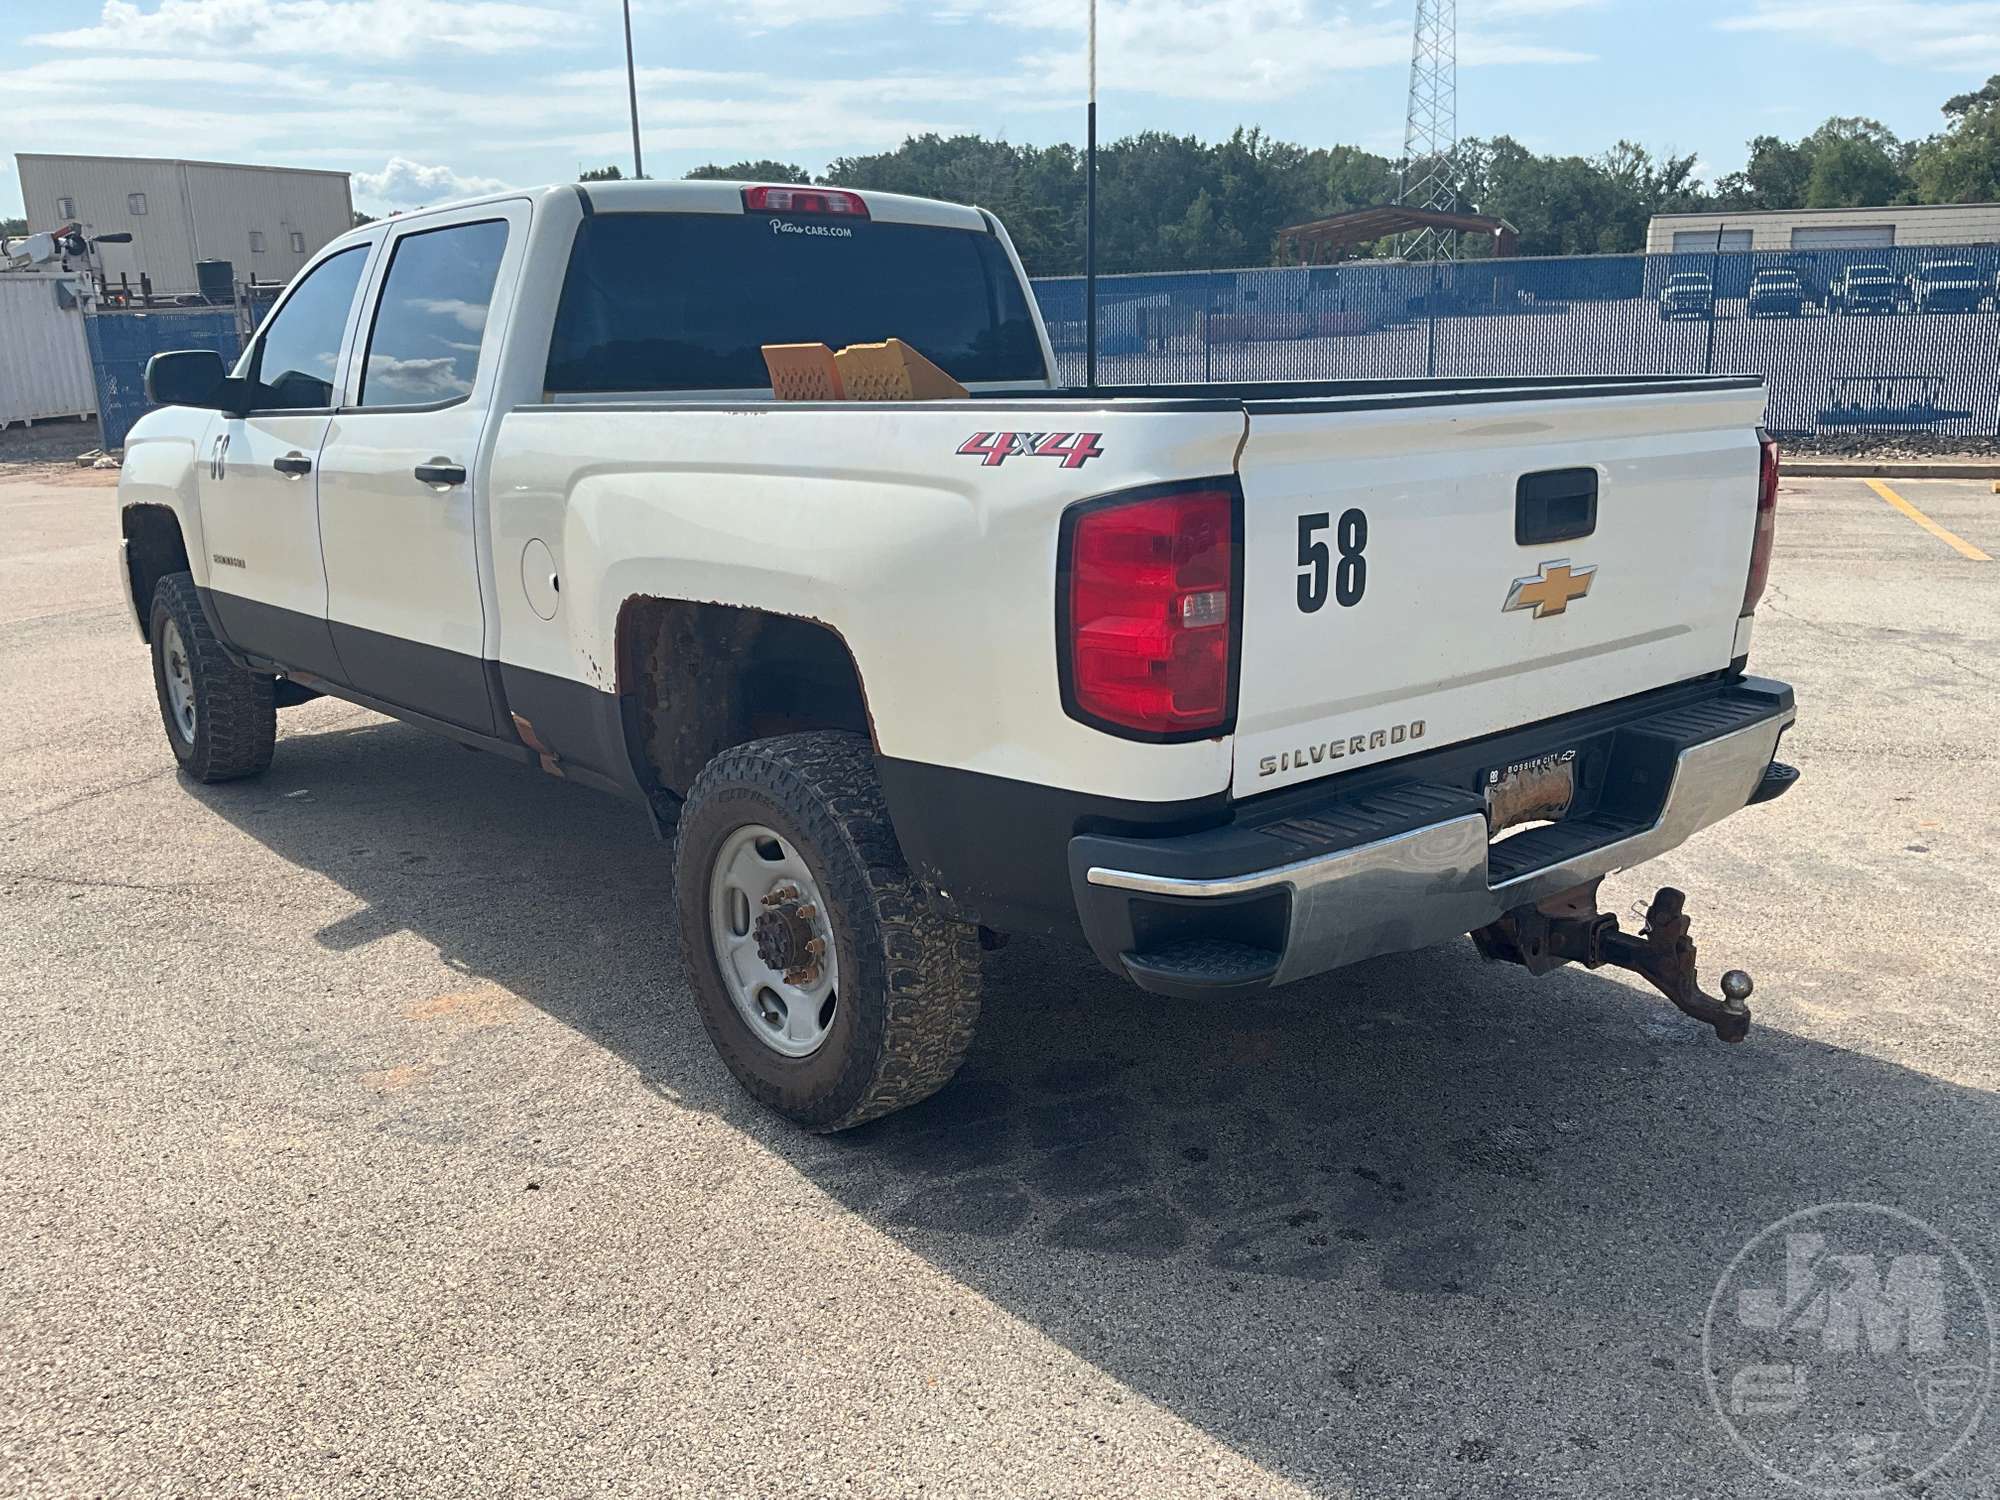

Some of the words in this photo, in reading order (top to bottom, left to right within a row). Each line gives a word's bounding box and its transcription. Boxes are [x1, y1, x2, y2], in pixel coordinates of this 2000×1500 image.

[1296, 508, 1368, 613] 58
[1258, 719, 1426, 777] SILVERADO
[1507, 759, 1541, 774] BOSSIER
[1543, 753, 1558, 765] CITY
